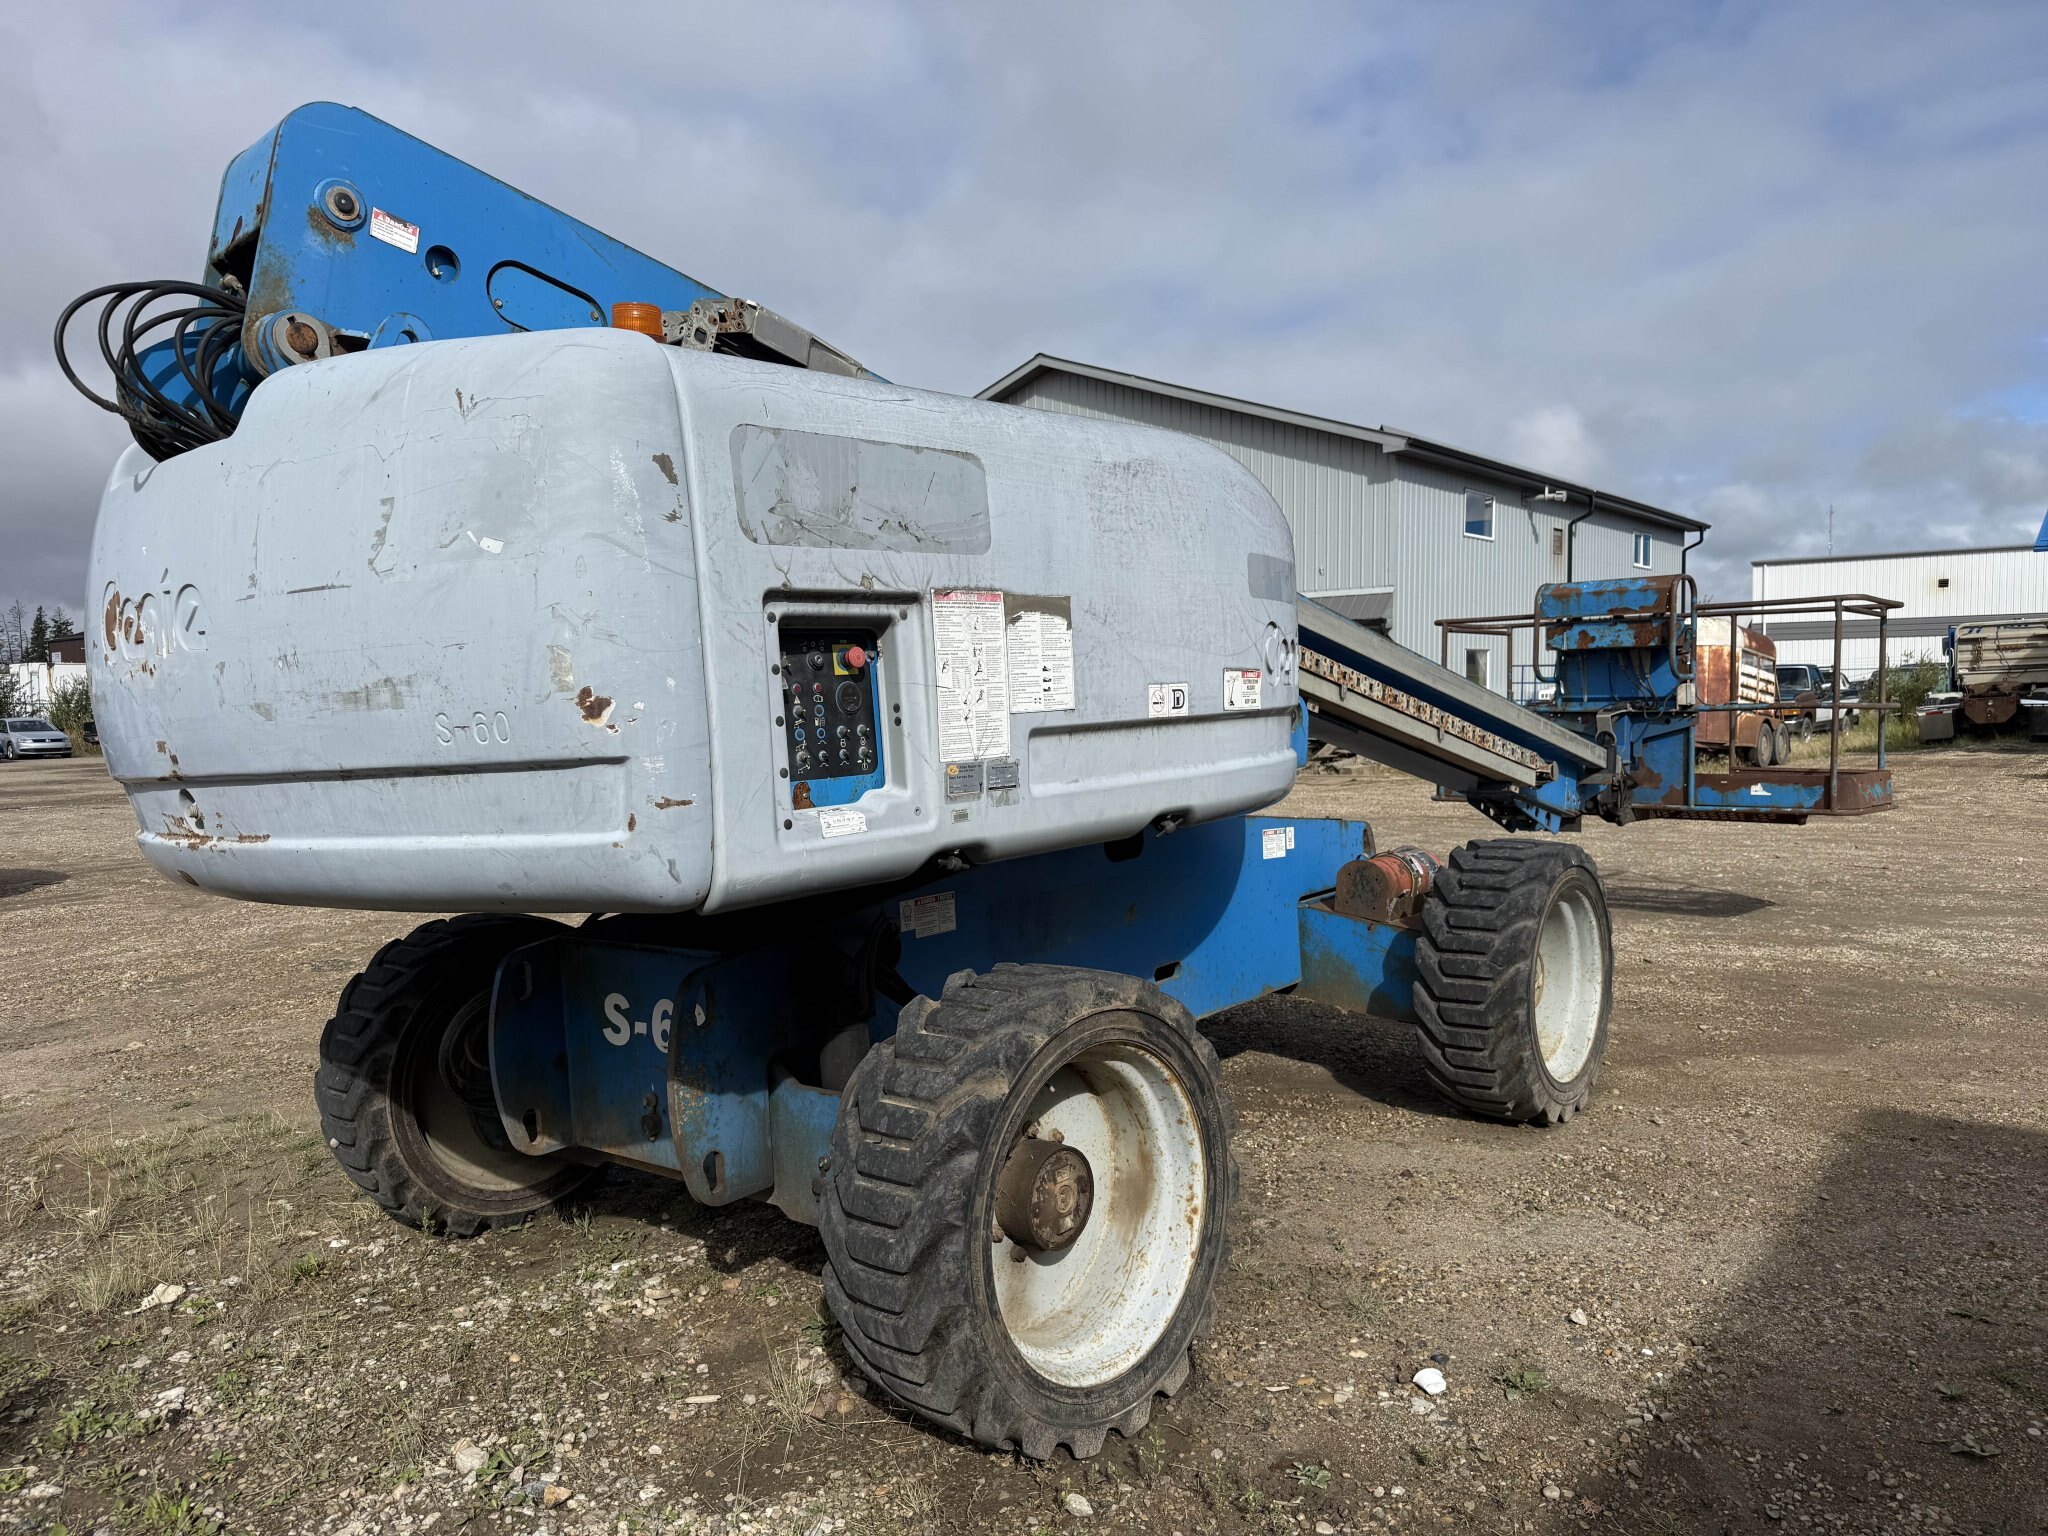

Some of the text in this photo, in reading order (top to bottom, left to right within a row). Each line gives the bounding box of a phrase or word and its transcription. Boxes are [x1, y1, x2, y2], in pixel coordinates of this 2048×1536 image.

[102, 568, 207, 664] Genie
[1172, 689, 1185, 709] D
[435, 711, 510, 745] S-60
[602, 992, 705, 1054] S-6
